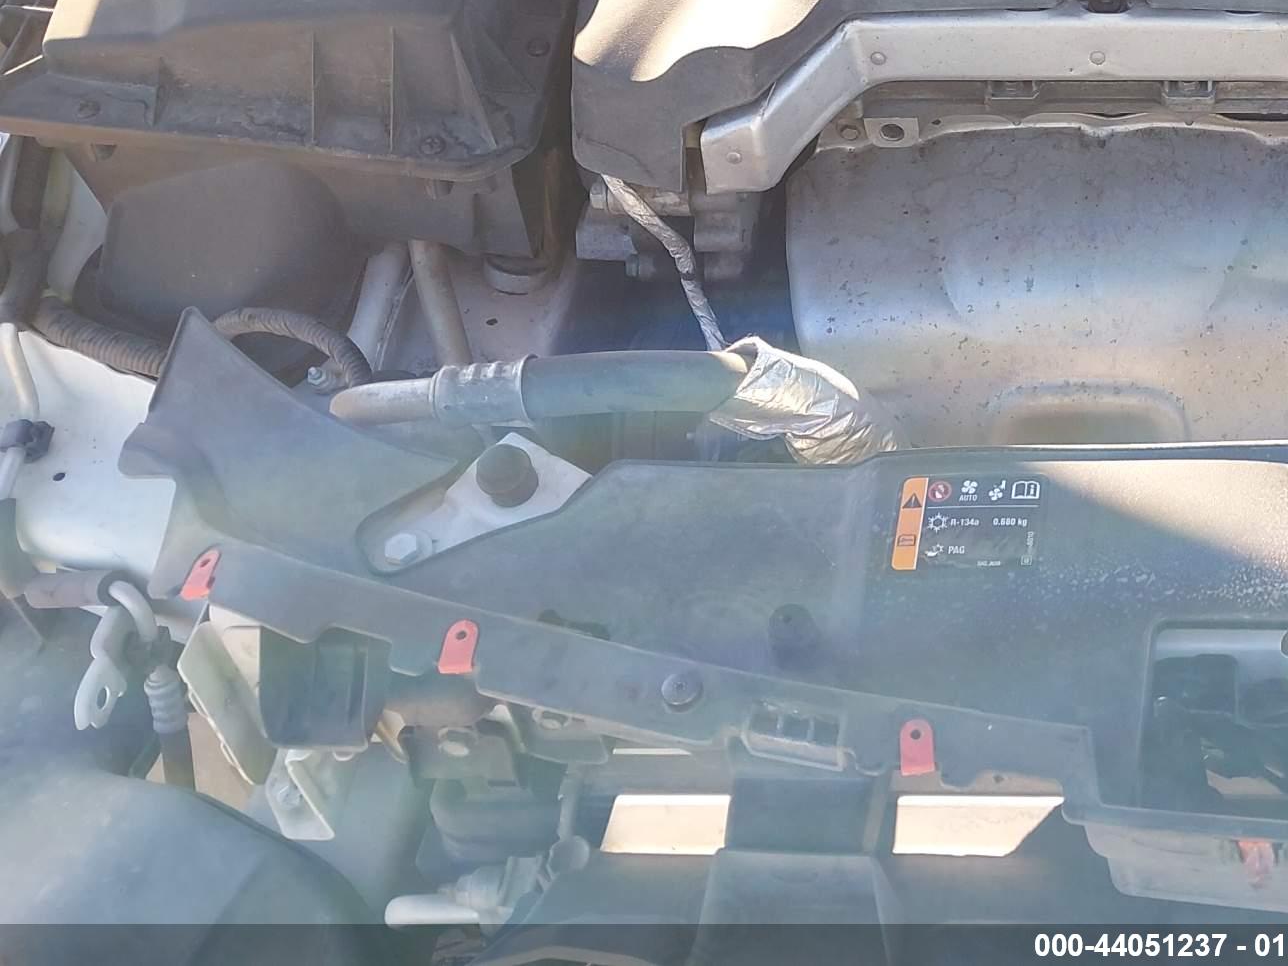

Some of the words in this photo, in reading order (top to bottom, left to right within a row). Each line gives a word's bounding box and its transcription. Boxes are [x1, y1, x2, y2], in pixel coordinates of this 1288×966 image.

[959, 494, 979, 502] AUTO
[1017, 517, 1028, 527] kg
[948, 545, 965, 555] PAG
